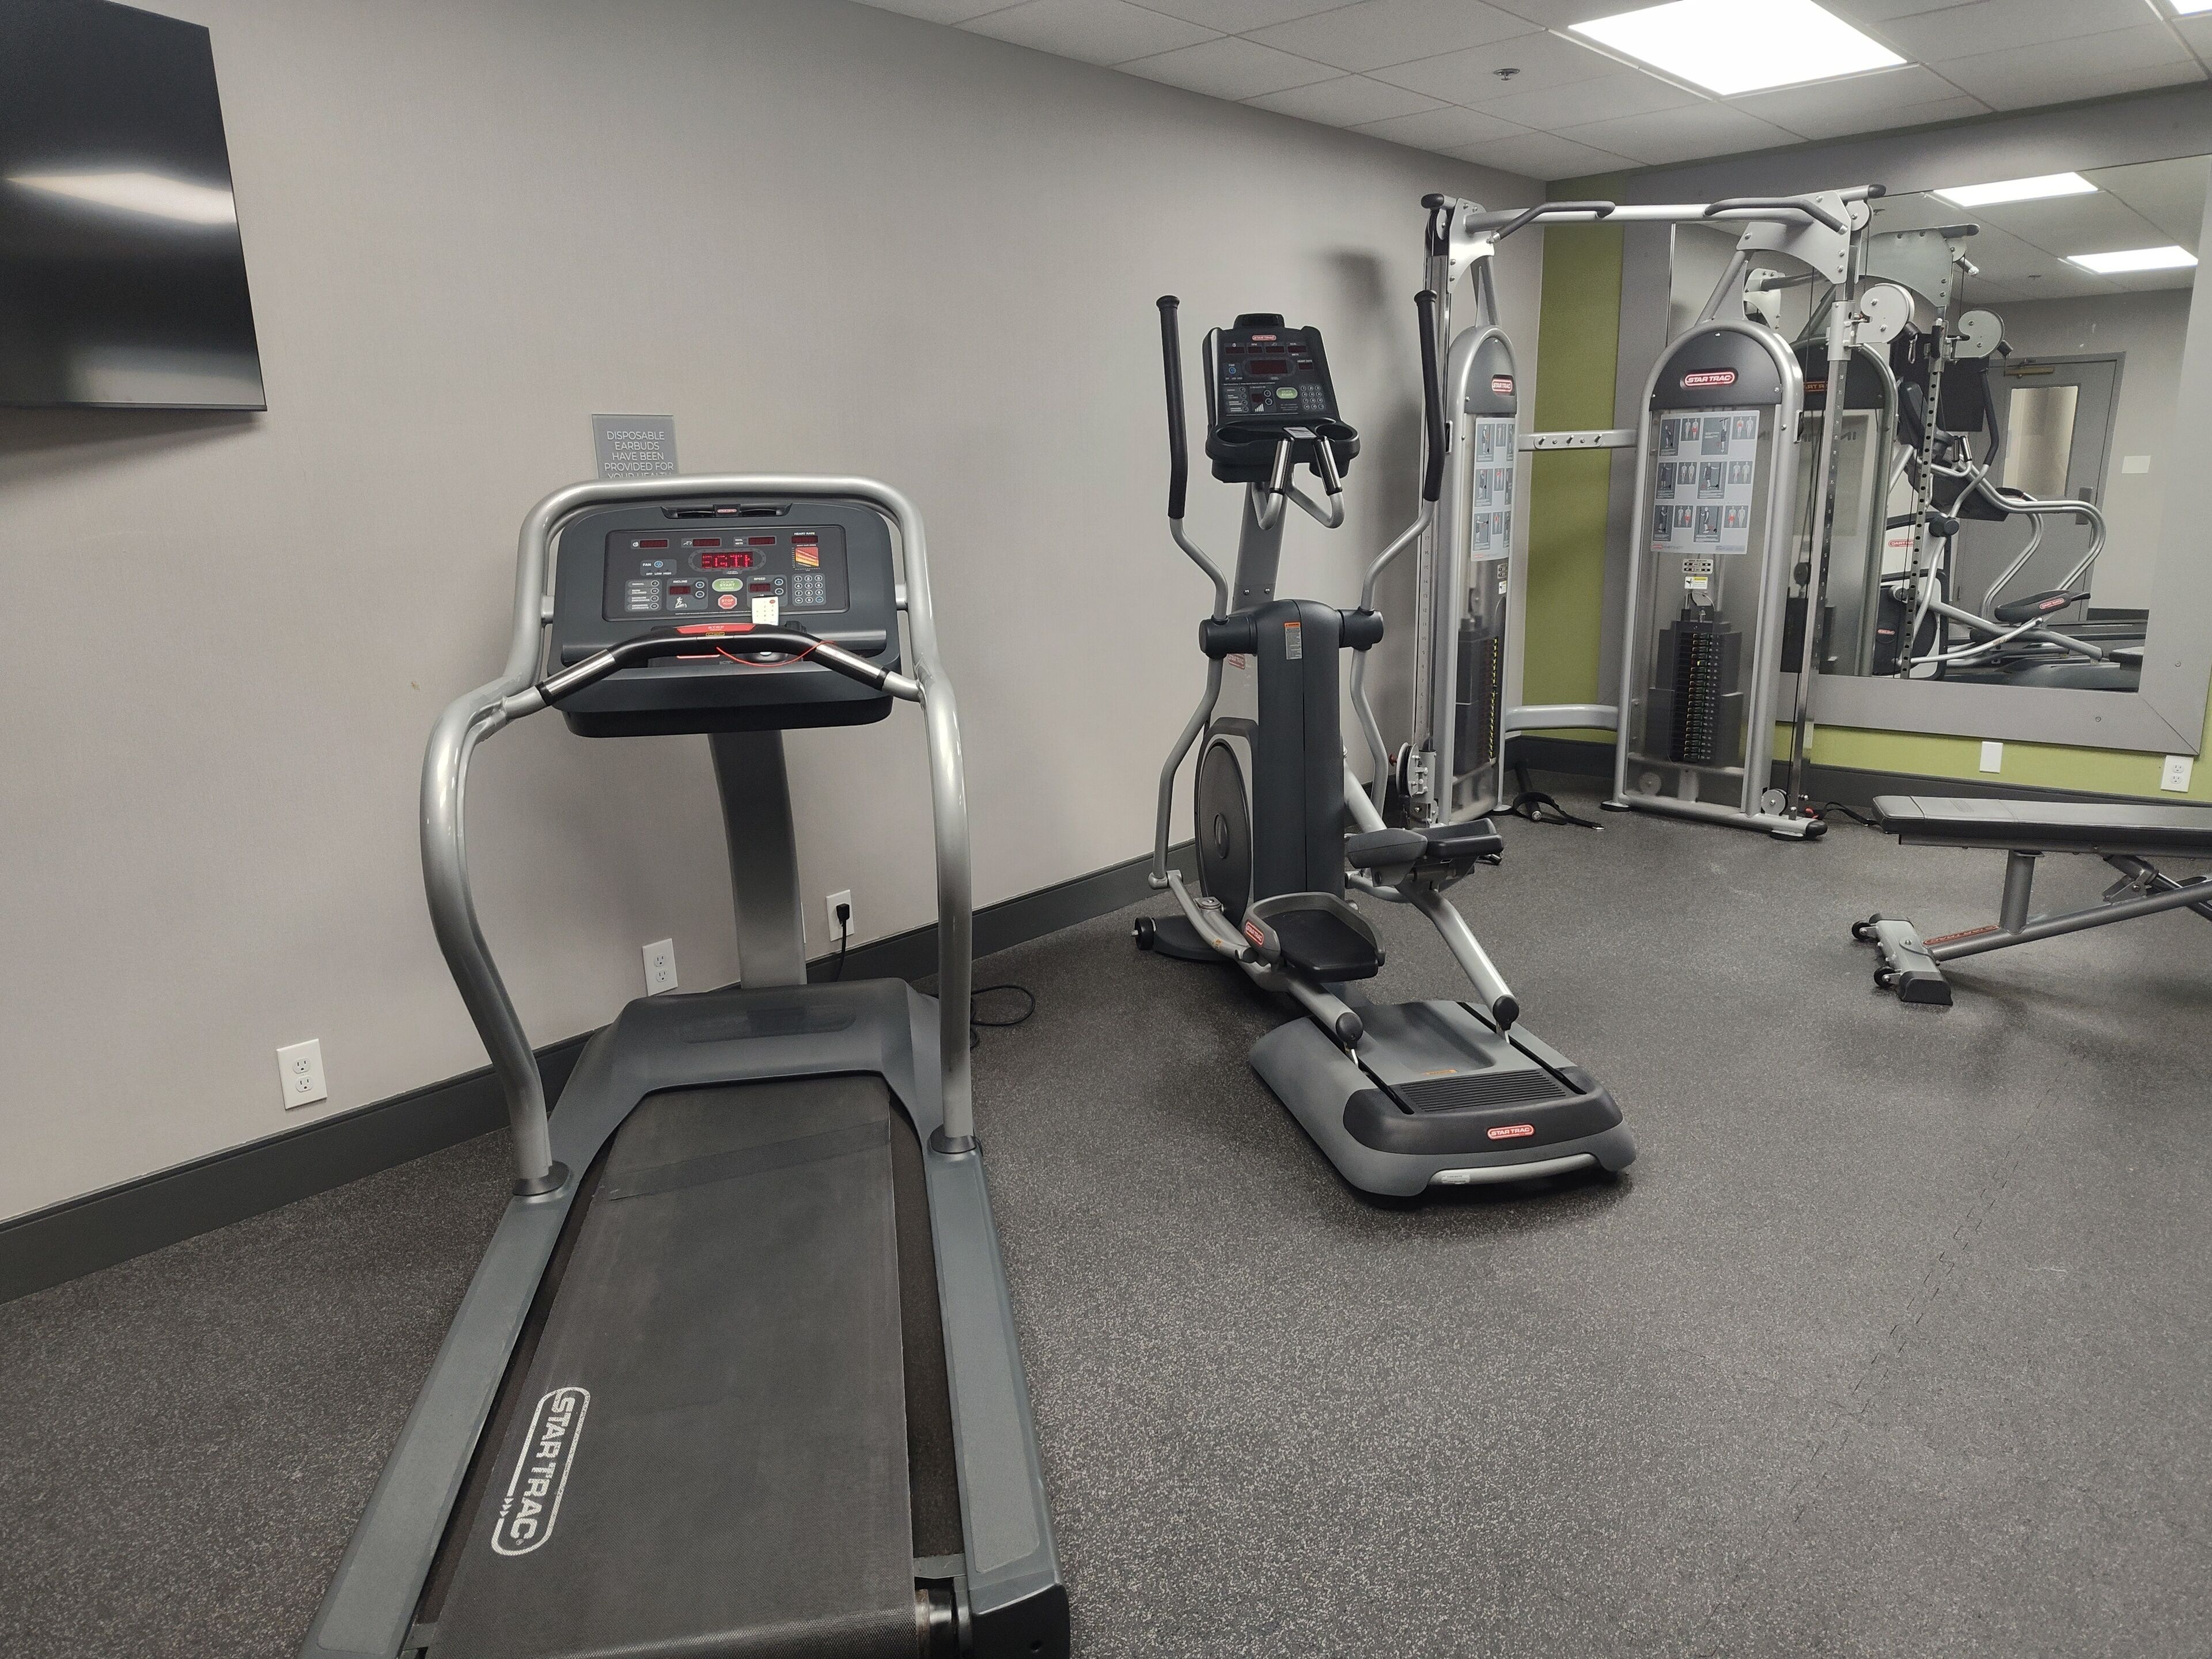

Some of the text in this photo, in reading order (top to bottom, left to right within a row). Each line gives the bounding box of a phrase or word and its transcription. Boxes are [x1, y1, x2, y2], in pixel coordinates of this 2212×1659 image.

[607, 431, 665, 440] DISPOSABLE
[615, 441, 660, 450] EARBUDS
[612, 452, 664, 461] HAVE BEEN
[604, 462, 674, 471] PROVIDED FOR
[510, 1396, 575, 1539] STAR TRAC
